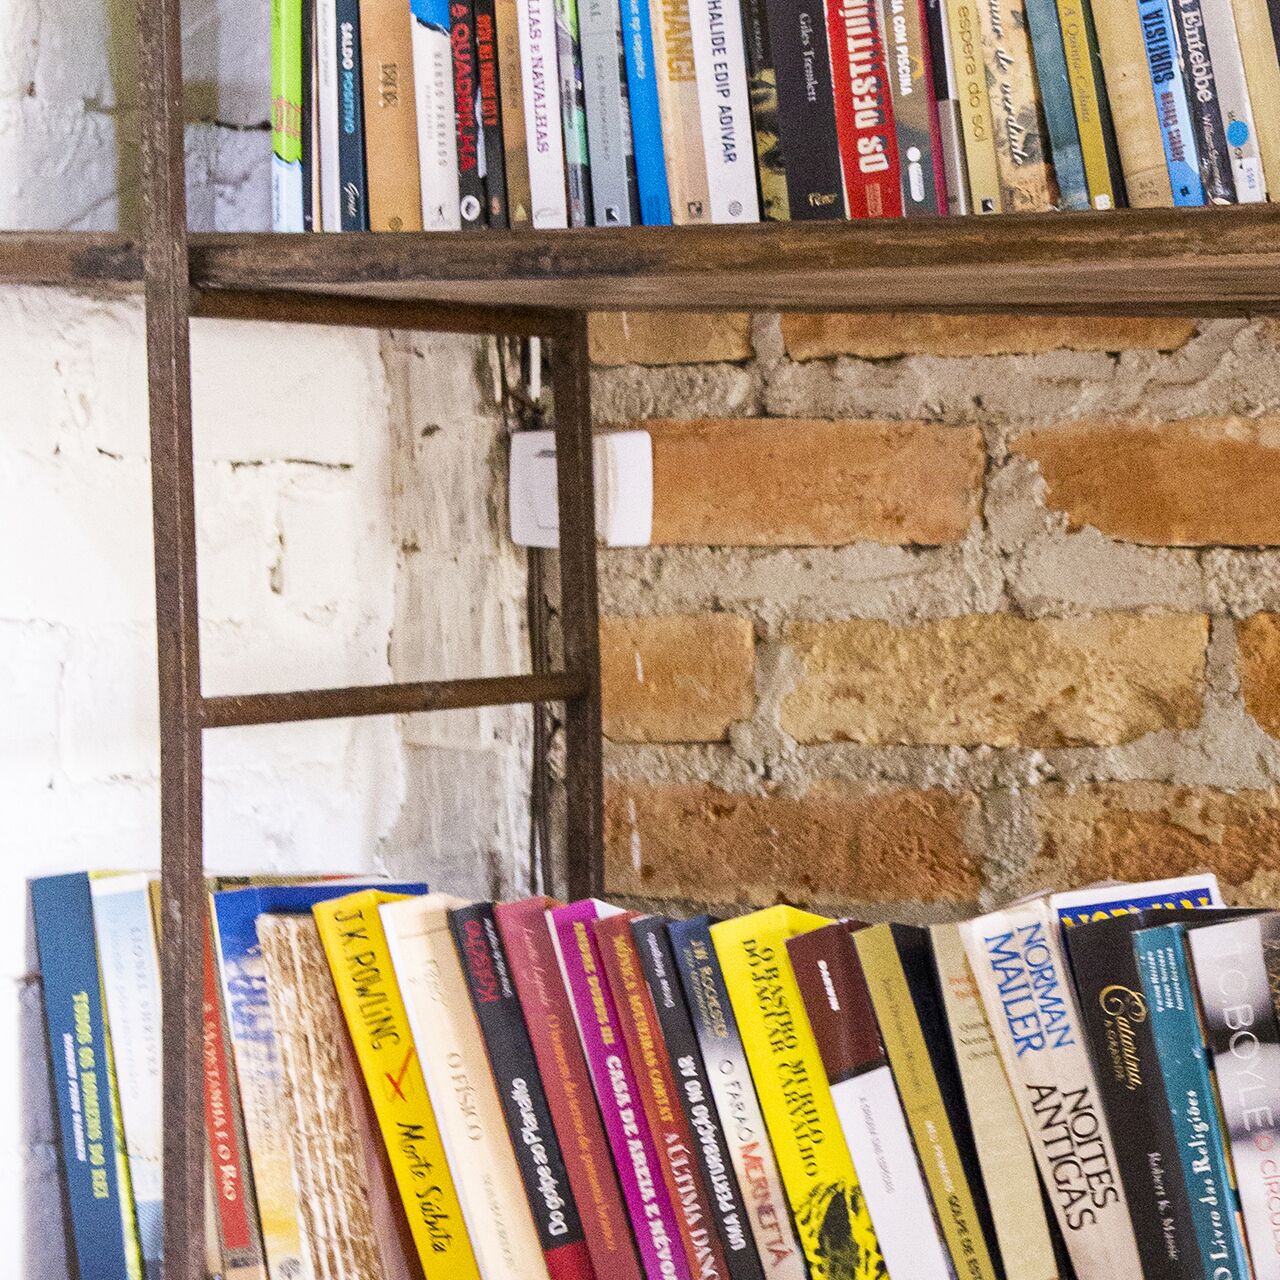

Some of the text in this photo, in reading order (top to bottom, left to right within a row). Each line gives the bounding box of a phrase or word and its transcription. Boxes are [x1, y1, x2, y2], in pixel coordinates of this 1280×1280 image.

[452, 3, 469, 18] A
[708, 0, 728, 57] HALIDE
[893, 16, 908, 37] COM
[957, 5, 976, 73] espera
[895, 38, 913, 96] PISCINA
[1143, 7, 1176, 86] SURFISTA
[1181, 9, 1214, 104] Entebbe
[451, 22, 477, 171] QUADRILHA
[713, 61, 731, 100] EDIP
[966, 82, 982, 108] do
[719, 104, 738, 164] ADIVAR
[856, 136, 890, 174] OS
[970, 112, 988, 143] sol
[742, 938, 786, 1054] DO JAGUAR
[762, 947, 800, 1050] O RASTRO
[983, 930, 1047, 1058] MAILER
[1016, 921, 1076, 1051] NORMAN
[606, 1055, 632, 1108] CASA
[791, 1059, 825, 1145] MURILO
[620, 1107, 640, 1138] DE
[664, 1131, 680, 1144] A
[776, 1061, 818, 1177] CARVALHO
[1062, 1085, 1120, 1210] NOITES
[1187, 1089, 1212, 1175] Religiões
[1253, 1134, 1275, 1153] O
[511, 1077, 569, 1237] Do golpe ao Planalto
[626, 1139, 657, 1204] AREIA
[666, 1143, 703, 1227] ÚLTIMA
[677, 1054, 747, 1252] UMA PERTURBAÇÃO NO AR
[1025, 1082, 1098, 1232] ANTIGAS
[396, 1121, 454, 1255] Morte Súbita
[643, 1202, 661, 1219] E
[1199, 1175, 1220, 1207] das
[1207, 1208, 1231, 1262] Livro
